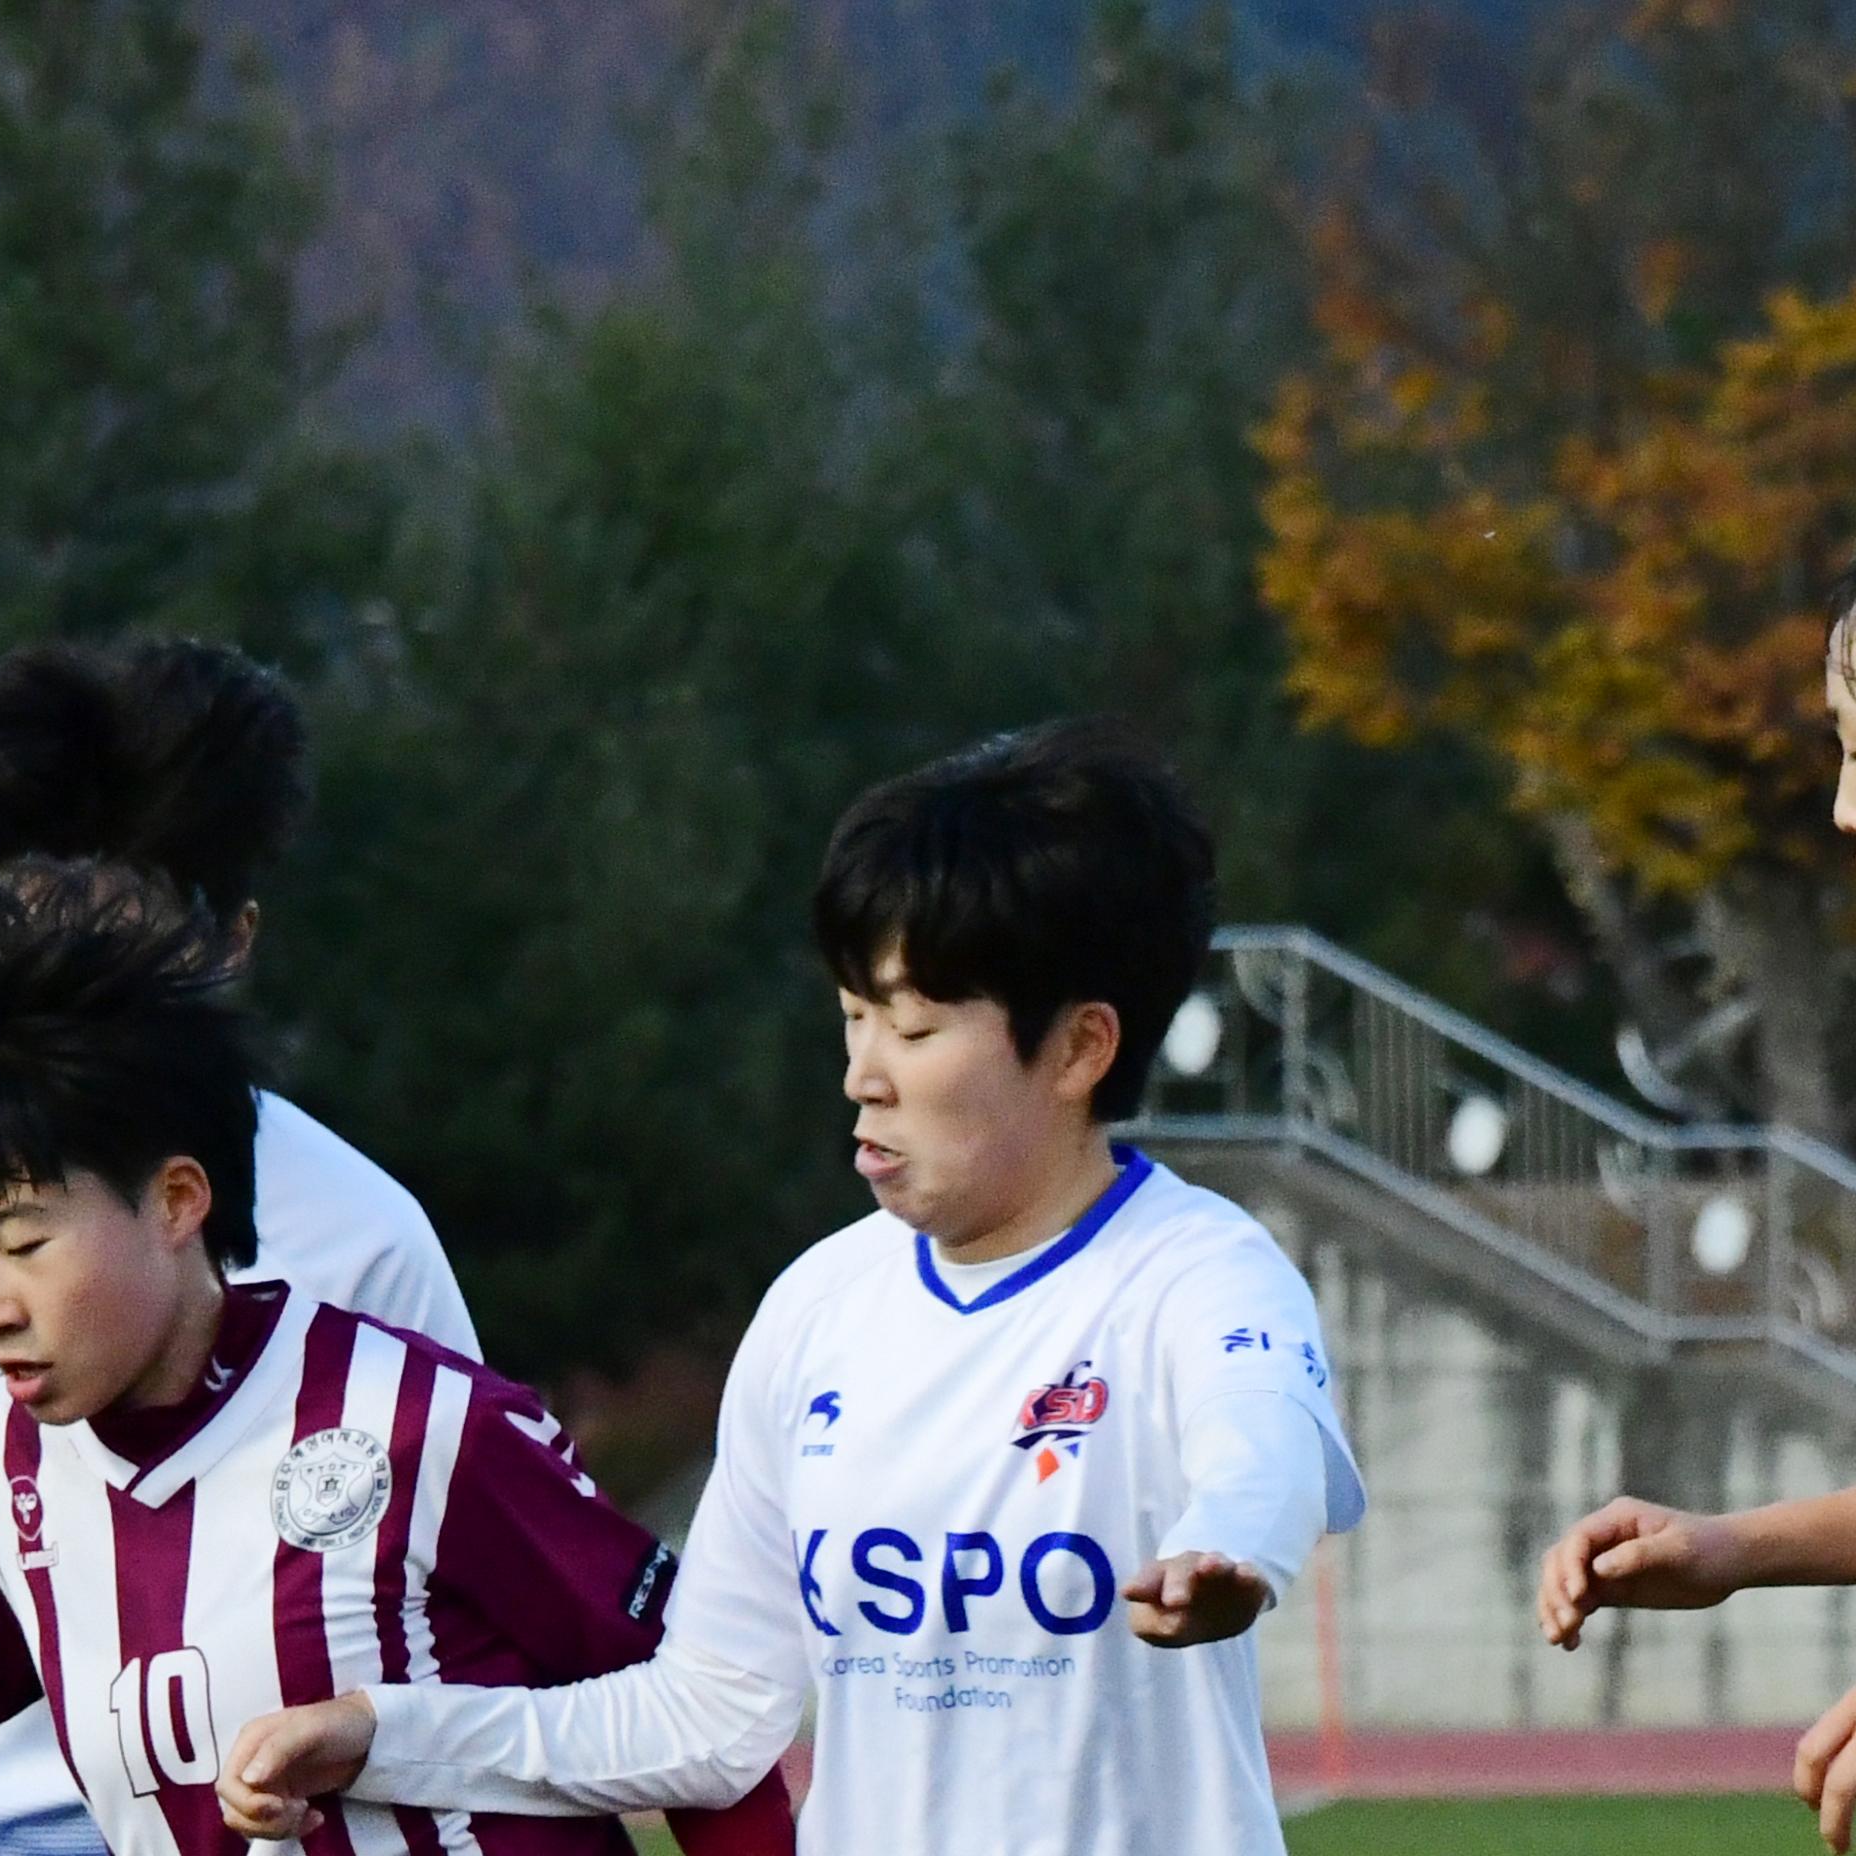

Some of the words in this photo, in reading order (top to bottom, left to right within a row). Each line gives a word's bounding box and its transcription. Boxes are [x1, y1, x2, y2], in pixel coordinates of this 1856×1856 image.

[792, 1527, 1116, 1636] KSPO
[894, 1652, 956, 1678] Sports
[964, 1650, 1077, 1678] Promotion
[895, 1684, 1013, 1713] Foundation
[109, 1645, 221, 1799] 10
